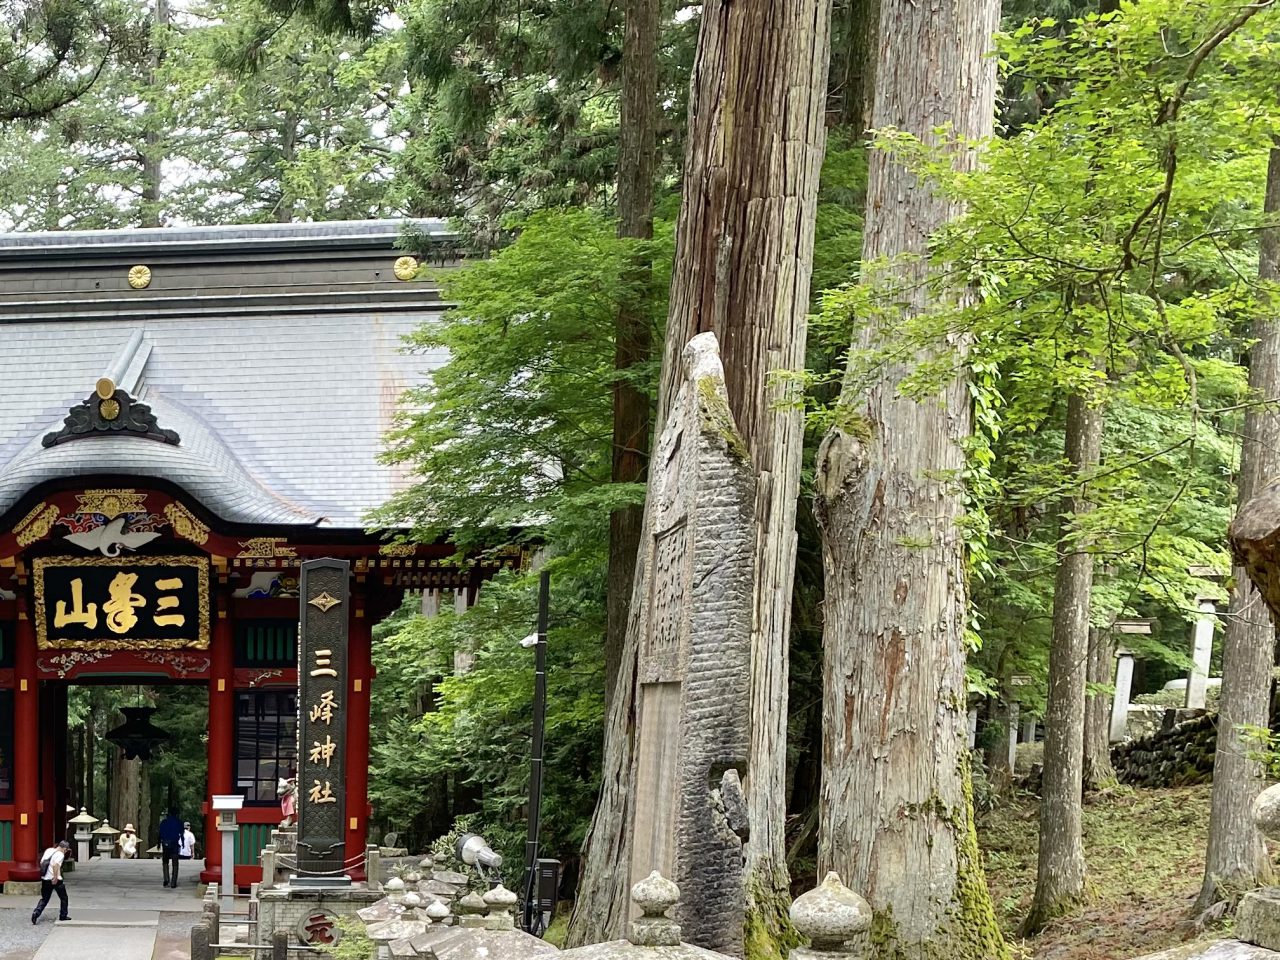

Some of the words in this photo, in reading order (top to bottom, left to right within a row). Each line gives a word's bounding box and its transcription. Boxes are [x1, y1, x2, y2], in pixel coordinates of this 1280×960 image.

[309, 649, 339, 804] 三峰神社
[304, 914, 335, 944] 元
